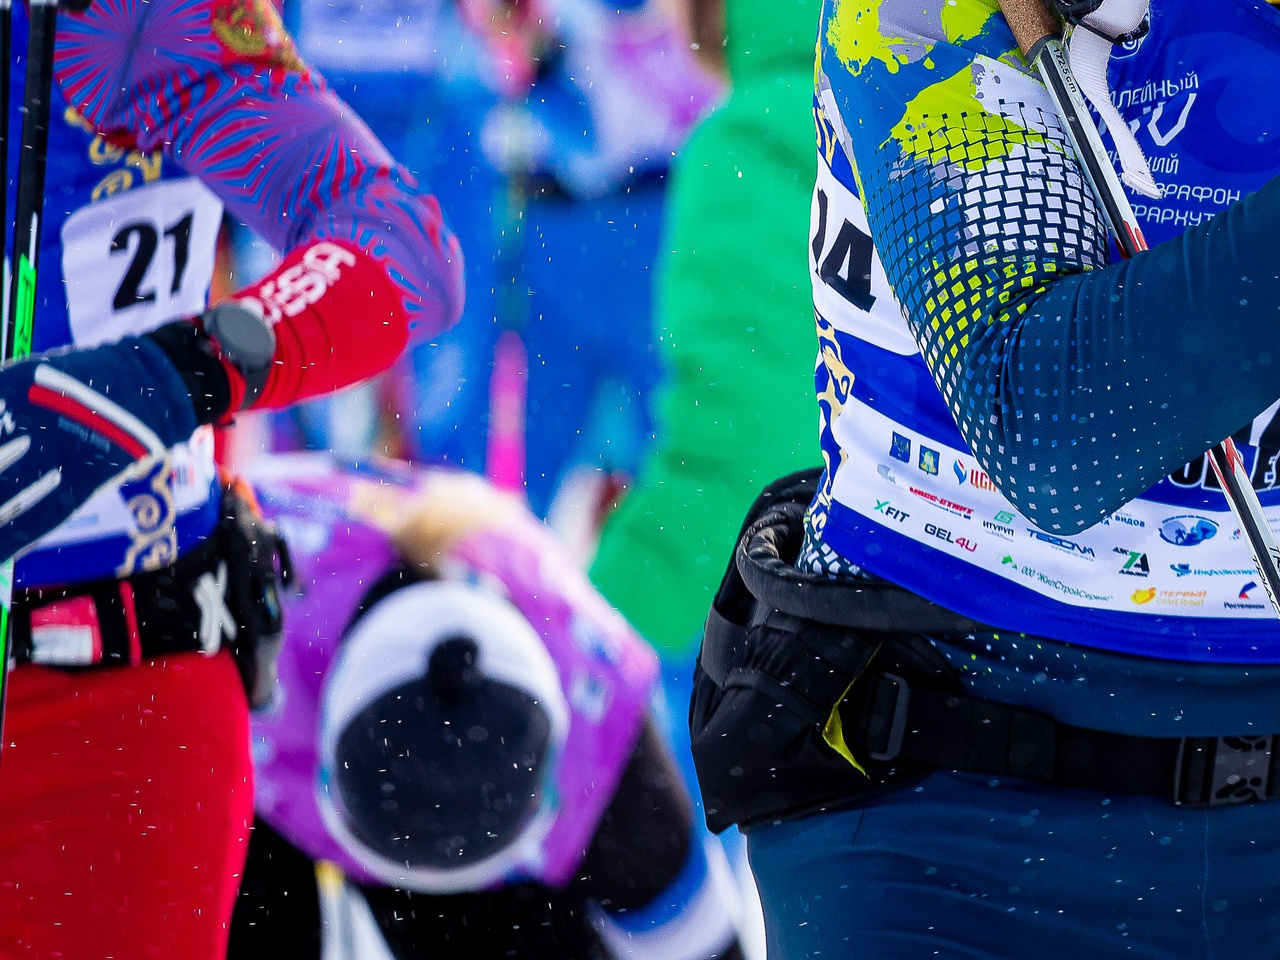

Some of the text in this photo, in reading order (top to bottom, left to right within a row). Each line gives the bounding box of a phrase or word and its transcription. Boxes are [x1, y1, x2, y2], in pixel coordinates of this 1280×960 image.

[1053, 47, 1077, 93] 172.5 cm
[108, 211, 195, 311] 21
[924, 523, 977, 552] GEL4U
